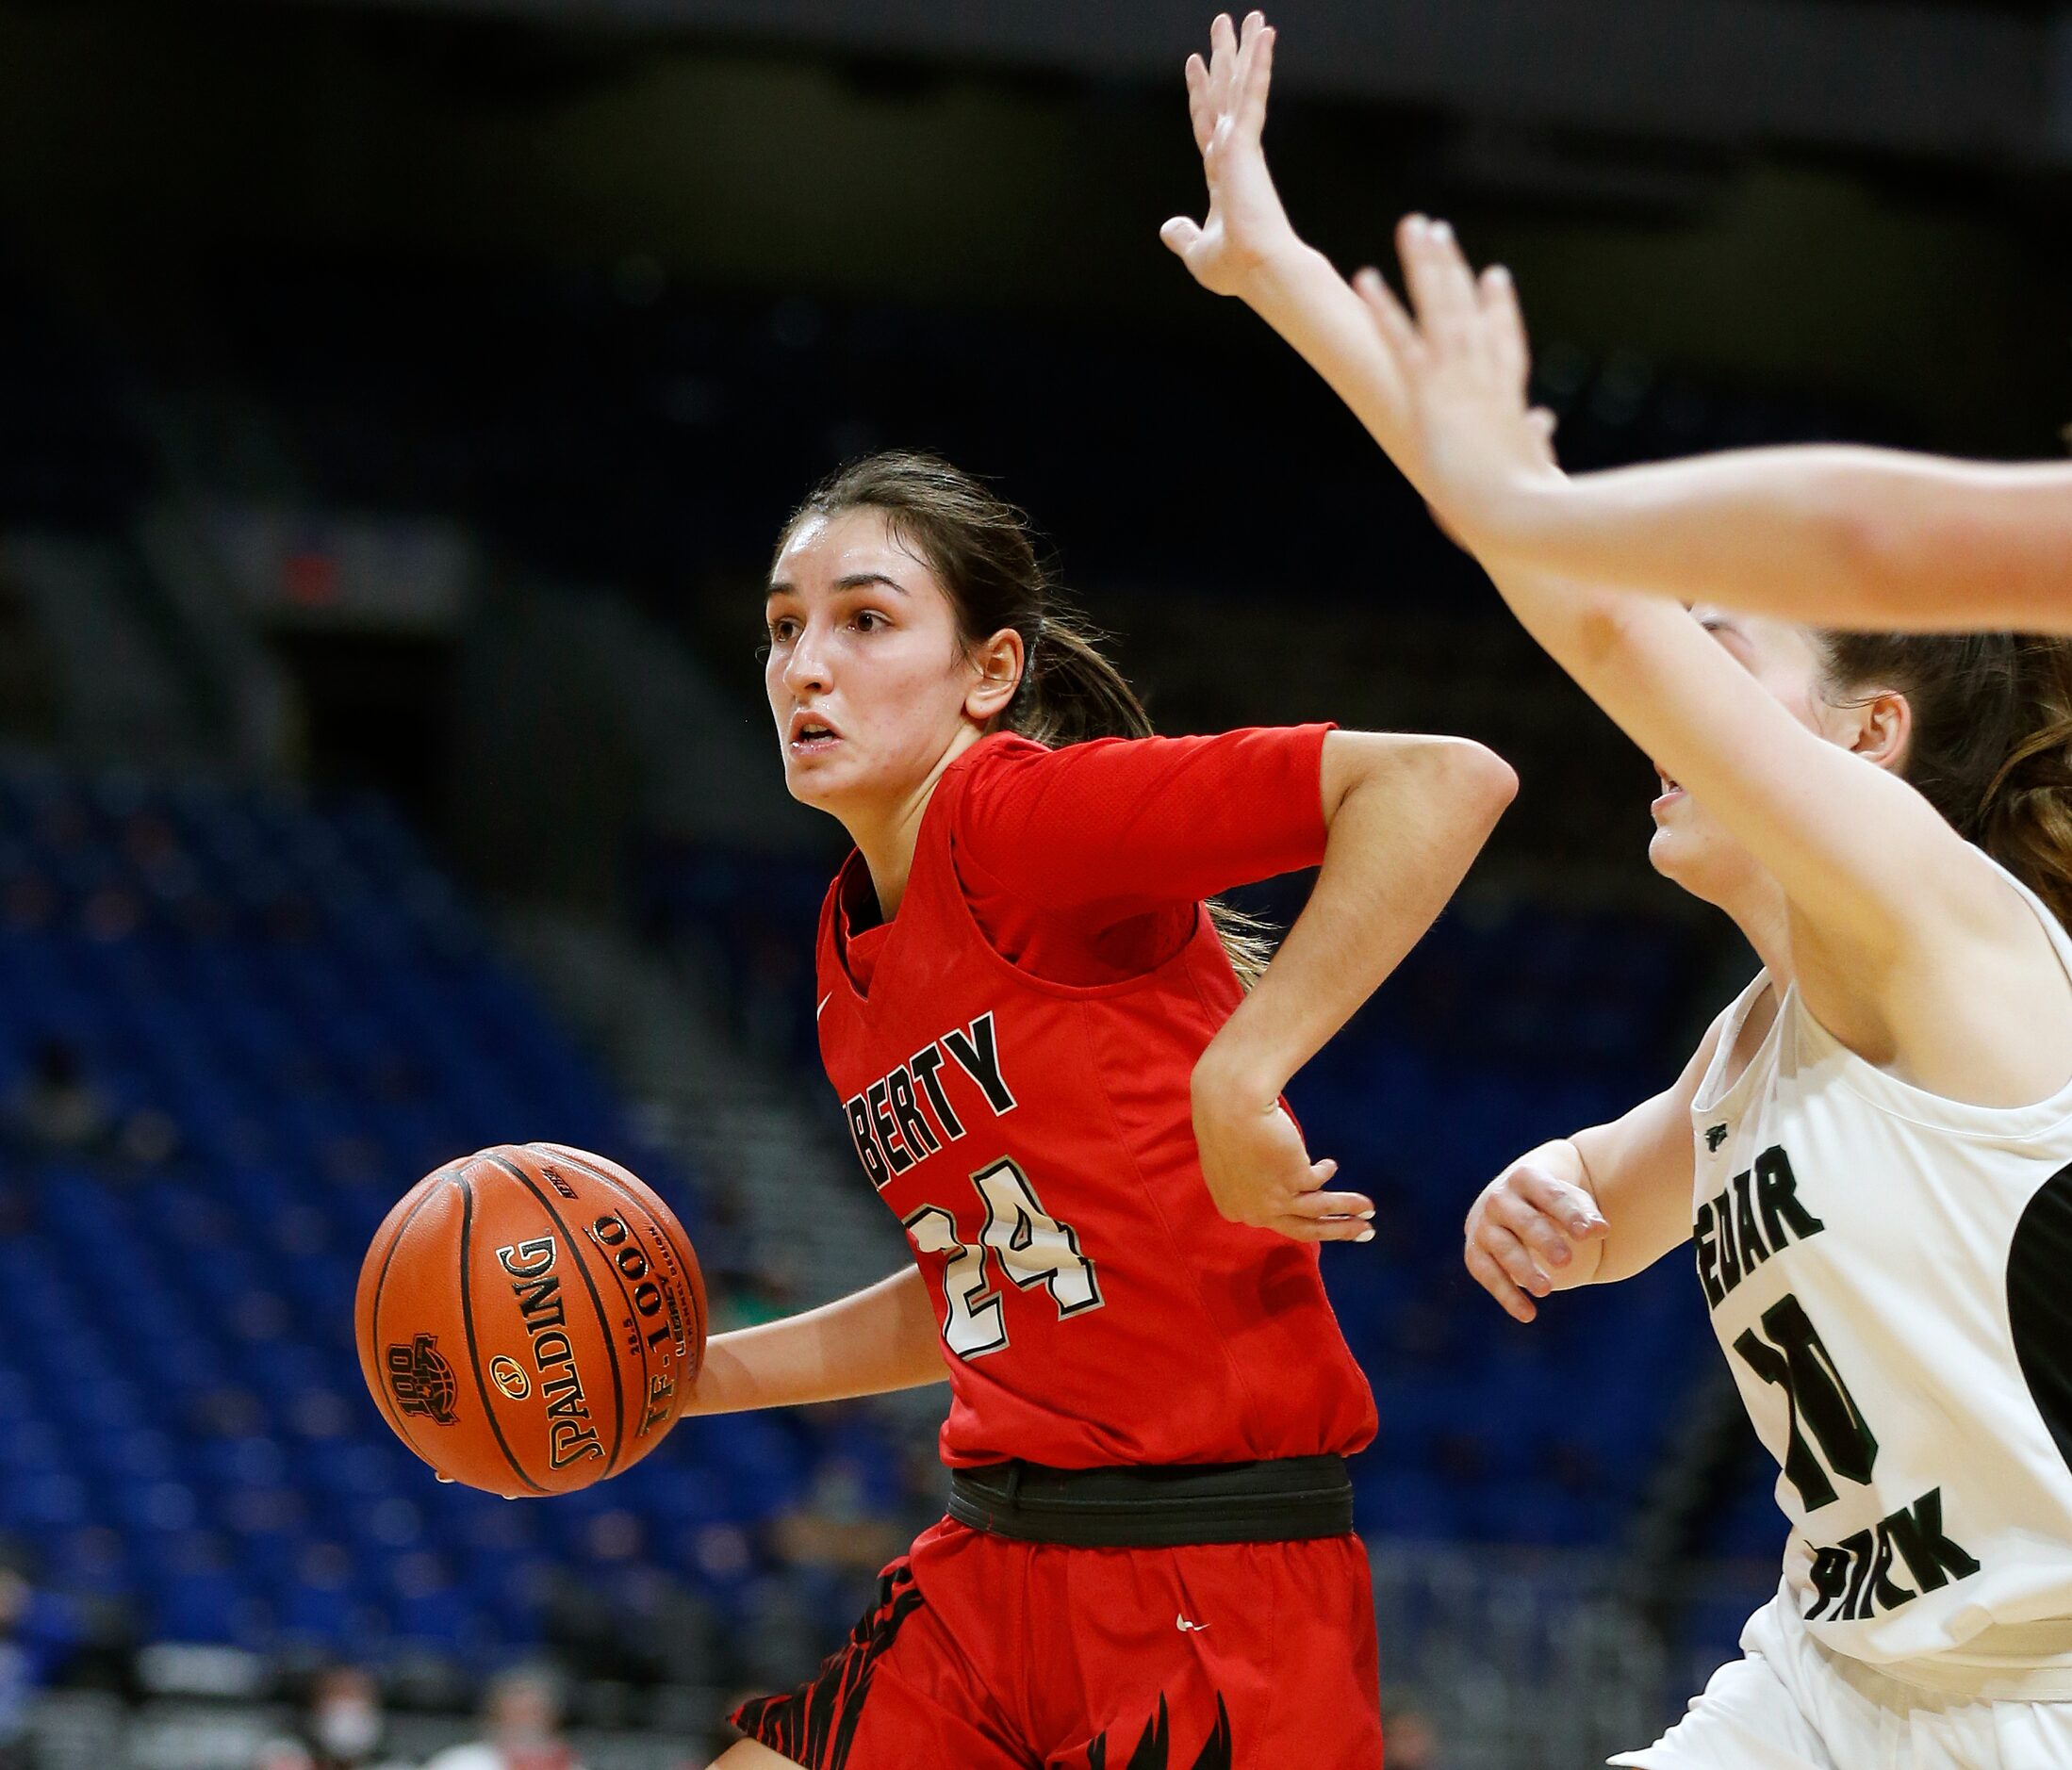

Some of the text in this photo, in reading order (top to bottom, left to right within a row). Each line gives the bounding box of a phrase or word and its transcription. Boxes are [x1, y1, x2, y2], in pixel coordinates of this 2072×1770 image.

[843, 1010, 1017, 1191] BERTY
[902, 1155, 1105, 1361] 24
[1694, 1144, 1824, 1311] EDAR
[387, 1344, 432, 1417] 100
[495, 1235, 605, 1470] SPALDING
[621, 1318, 640, 1356] 28.5
[1733, 1293, 1879, 1513] 10
[1803, 1486, 1980, 1621] PARK
